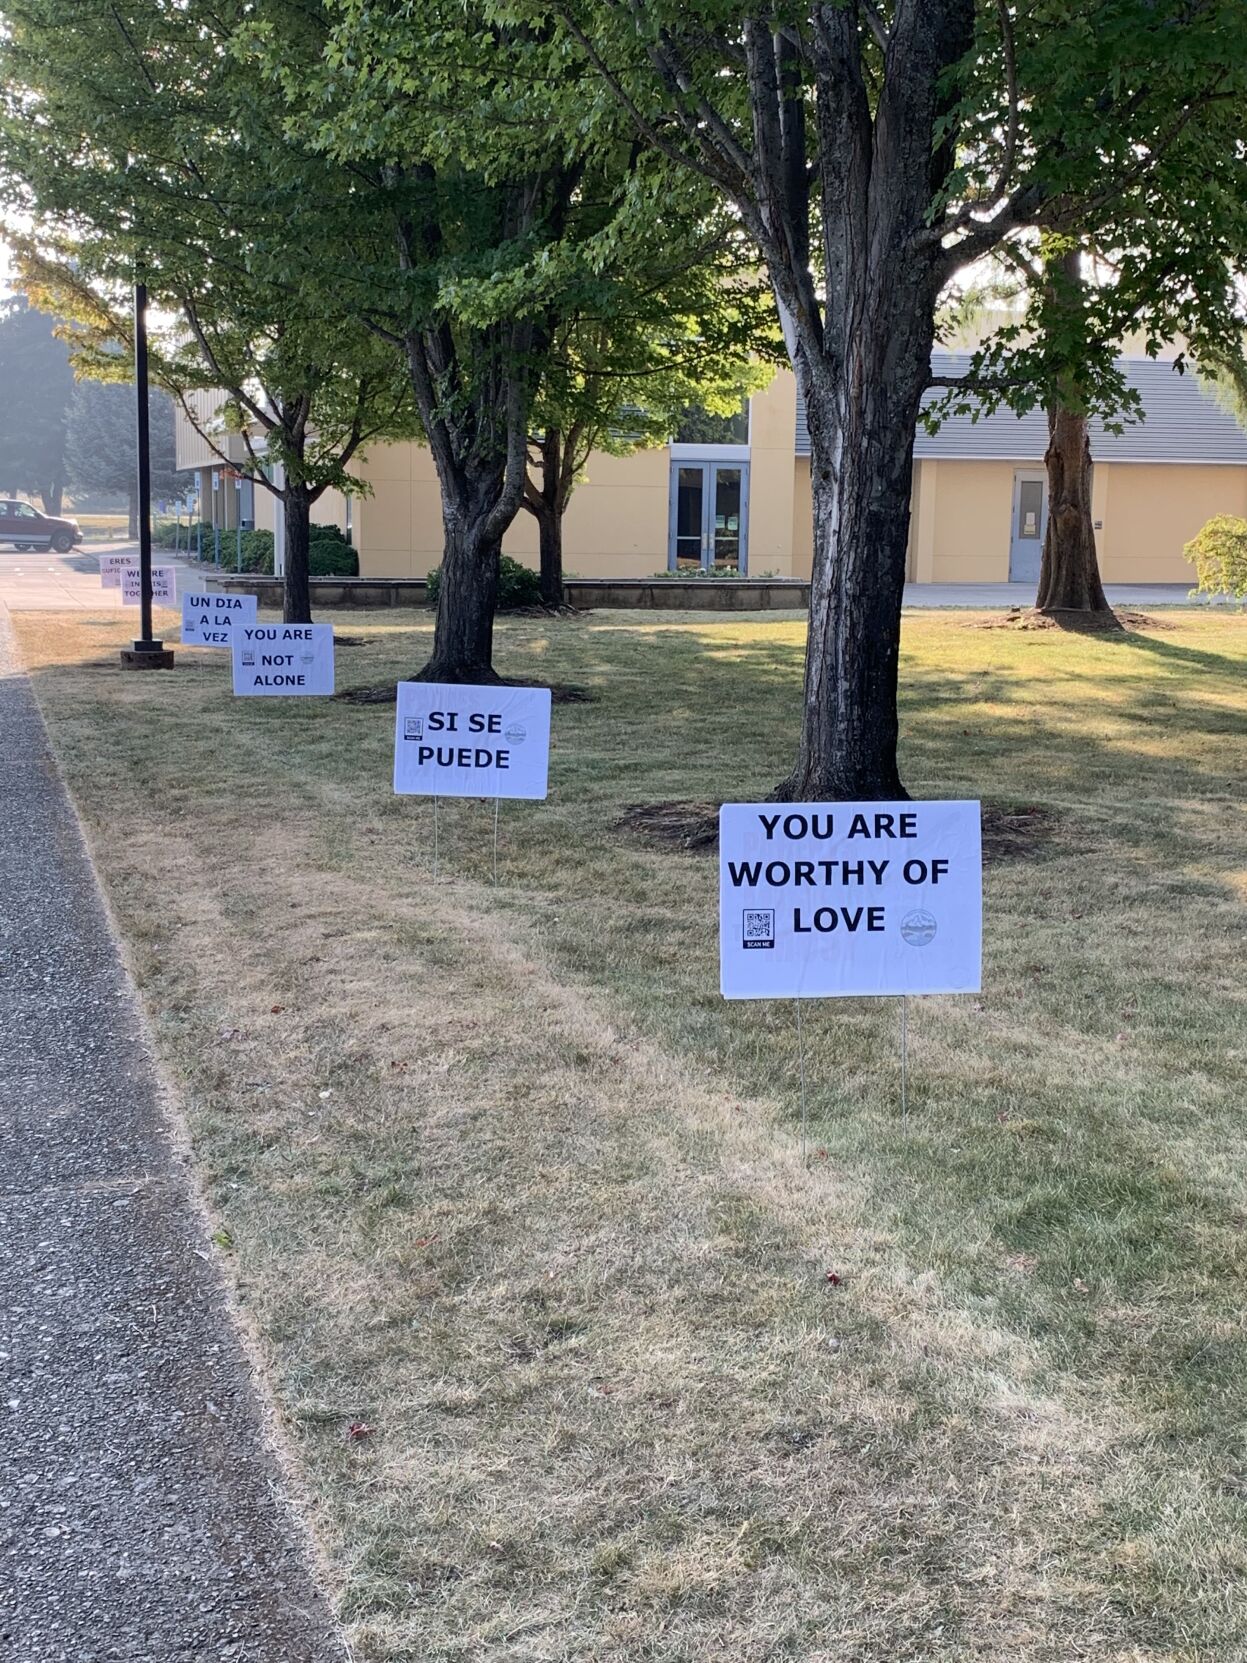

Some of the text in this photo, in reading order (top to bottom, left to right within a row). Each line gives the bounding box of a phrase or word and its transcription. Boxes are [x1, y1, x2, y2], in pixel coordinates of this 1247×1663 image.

[109, 557, 131, 565] ERES
[190, 596, 243, 609] UN DIA
[199, 614, 232, 626] A LA
[202, 631, 229, 642] VEZ
[244, 629, 313, 641] YOU ARE
[261, 655, 294, 666] NOT
[253, 675, 306, 686] ALONE
[428, 711, 502, 733] SI SE
[418, 746, 510, 769] PUEDE
[758, 813, 918, 840] YOU ARE
[727, 859, 949, 887] WORTHY OF
[793, 906, 886, 933] LOVE
